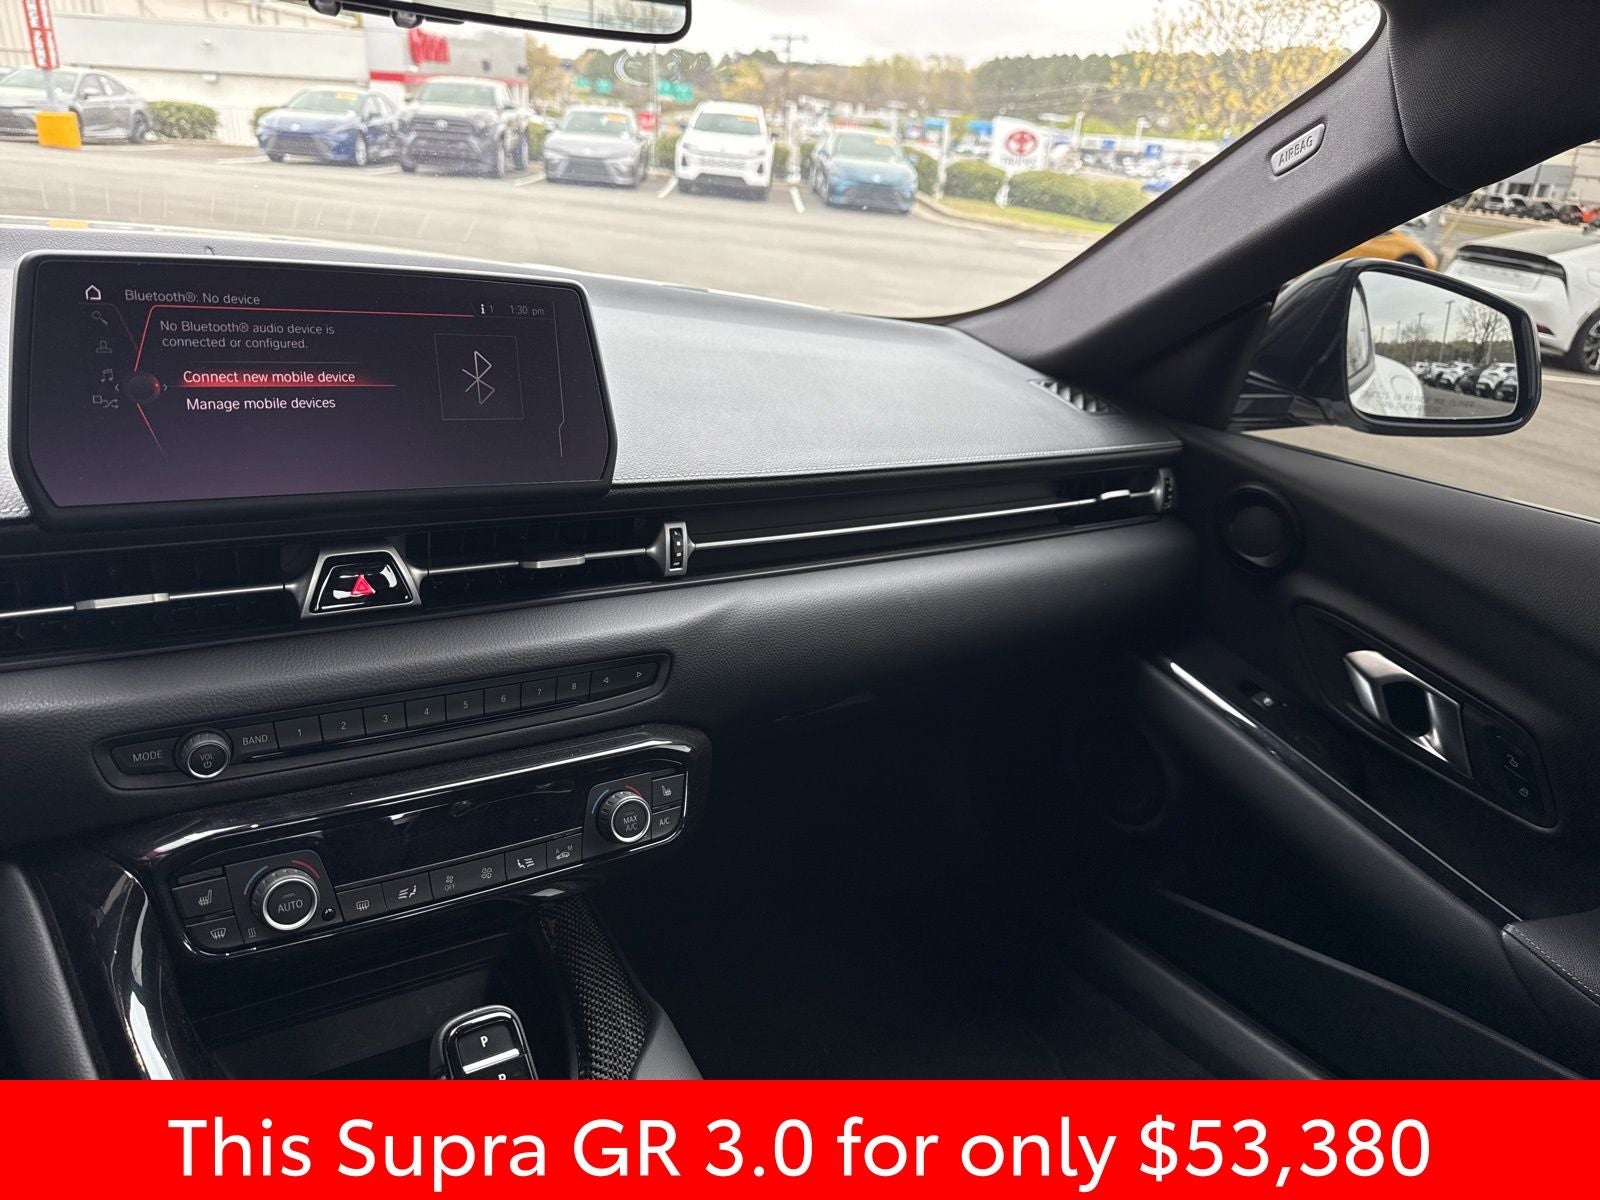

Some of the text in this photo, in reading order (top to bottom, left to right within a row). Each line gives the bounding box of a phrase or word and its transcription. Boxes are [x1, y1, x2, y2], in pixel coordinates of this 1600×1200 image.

[1278, 135, 1313, 167] AIRBAG
[202, 293, 219, 304] No
[223, 293, 260, 305] device
[510, 305, 545, 316] 1:30 pm
[160, 321, 177, 332] No
[253, 322, 284, 334] audio
[287, 323, 323, 335] device
[326, 323, 335, 335] is
[162, 337, 308, 351] connected or configured.
[183, 370, 356, 384] Connect new mobile device
[186, 397, 336, 412] Manage mobile devices
[571, 682, 577, 690] 8
[537, 688, 542, 696] 7
[501, 695, 507, 703] 6
[463, 701, 469, 709] 5
[423, 707, 429, 716] 4
[382, 714, 389, 723] 3
[341, 722, 347, 730] 2
[297, 728, 302, 737] 1
[242, 734, 269, 746] BAND
[132, 750, 163, 763] MODE
[200, 753, 214, 761] VOL
[623, 815, 638, 826] MAX
[659, 816, 671, 827] A/C
[625, 822, 639, 833] A/C
[444, 883, 456, 892] OFF
[277, 899, 304, 914] AUTO
[480, 1035, 489, 1048] P
